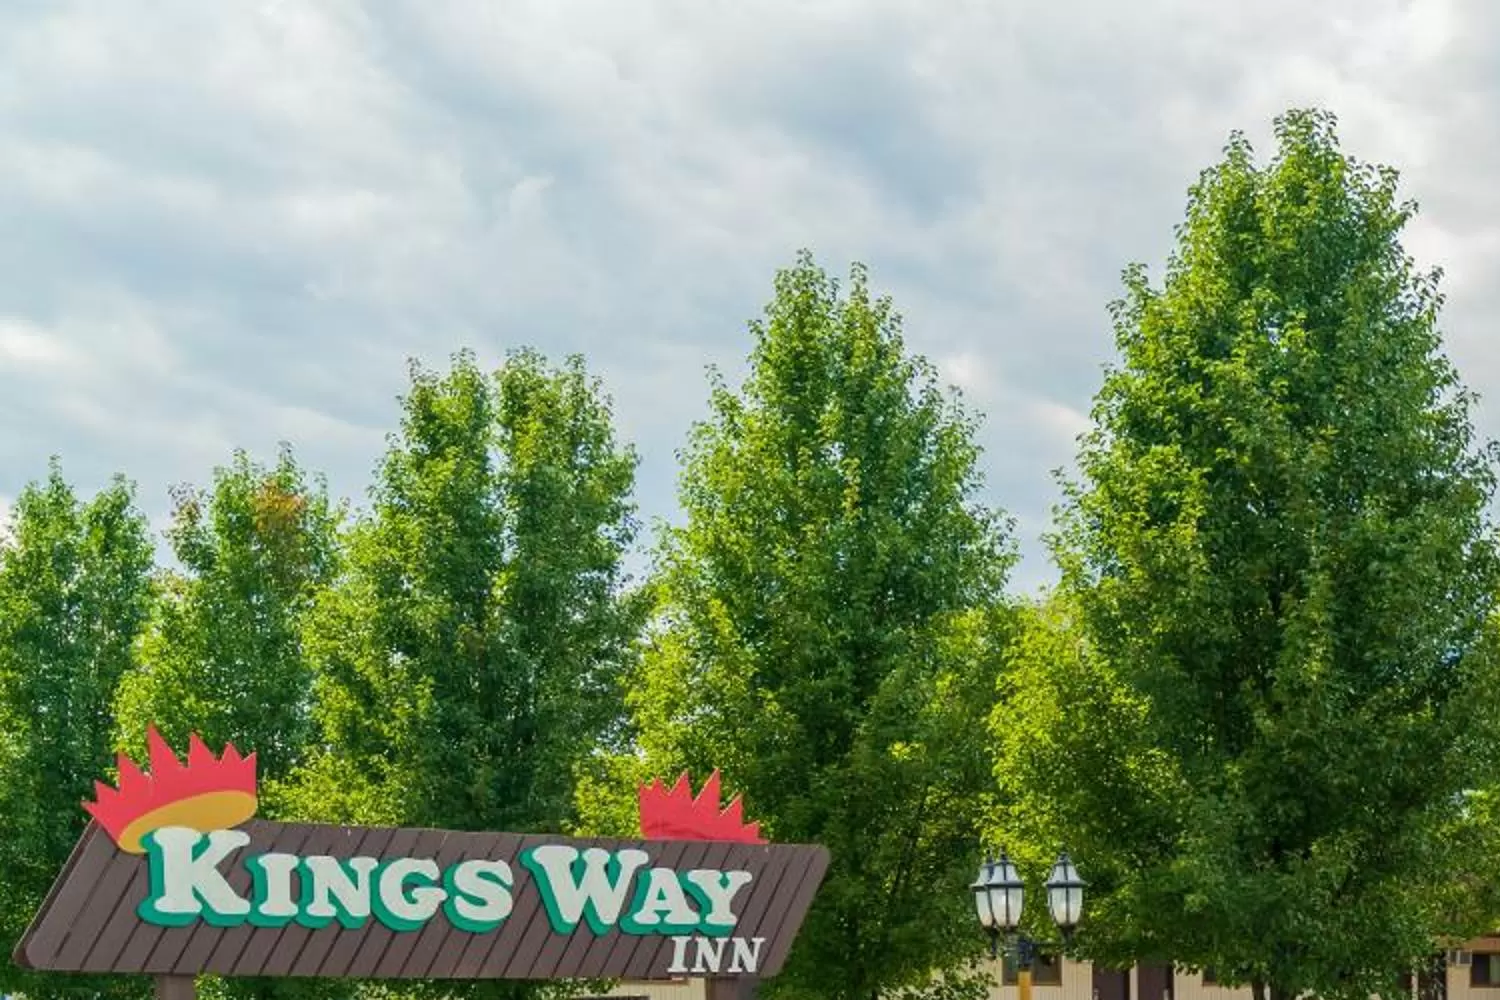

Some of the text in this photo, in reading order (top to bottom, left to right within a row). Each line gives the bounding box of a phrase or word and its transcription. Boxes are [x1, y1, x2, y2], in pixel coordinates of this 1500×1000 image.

[139, 826, 753, 937] KINGS WAY
[668, 937, 766, 974] INN
